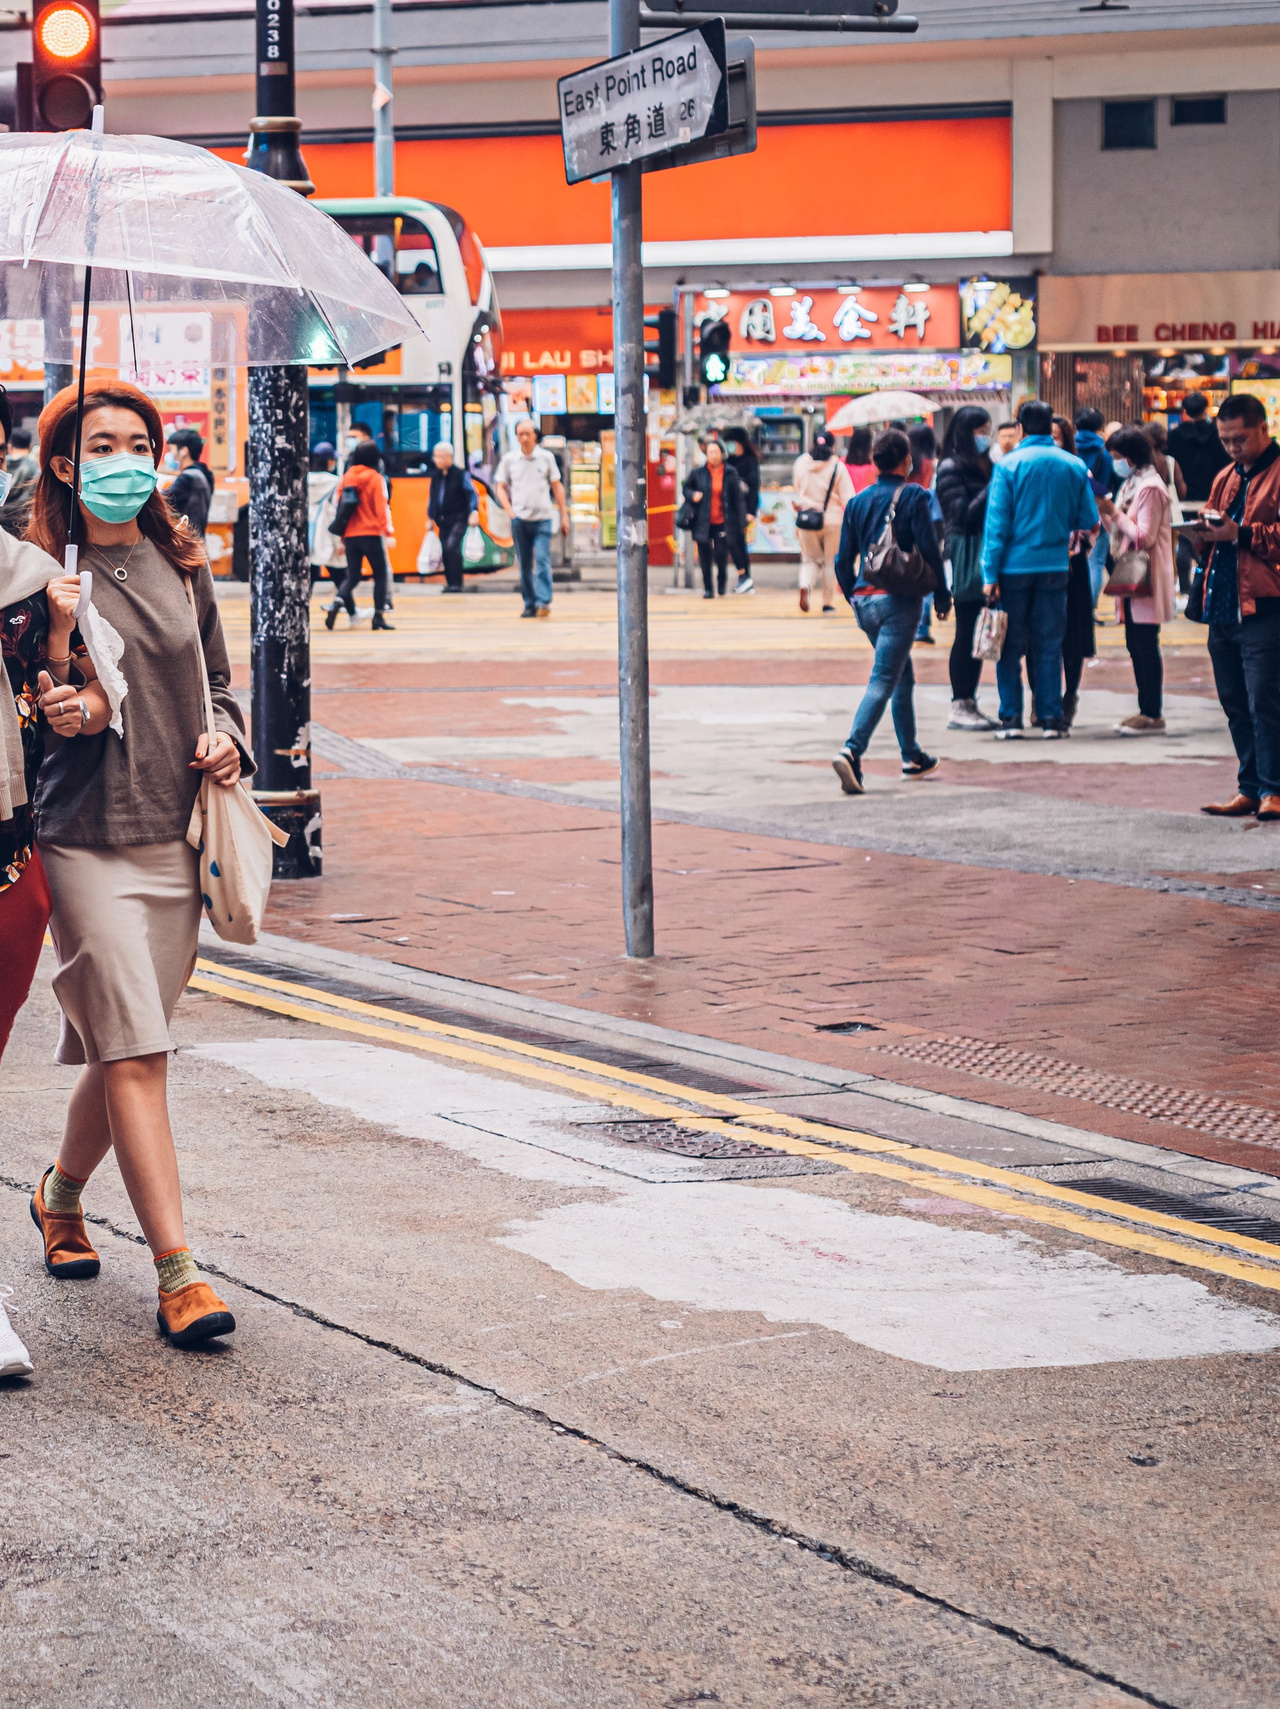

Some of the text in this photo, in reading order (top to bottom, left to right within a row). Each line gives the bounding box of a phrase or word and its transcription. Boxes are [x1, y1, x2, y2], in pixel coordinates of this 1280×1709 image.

[564, 45, 697, 117] East Point Road
[599, 99, 695, 156] 東角道 26
[1097, 325, 1139, 342] BEE
[1154, 322, 1237, 341] CHENG
[522, 350, 572, 369] LAU
